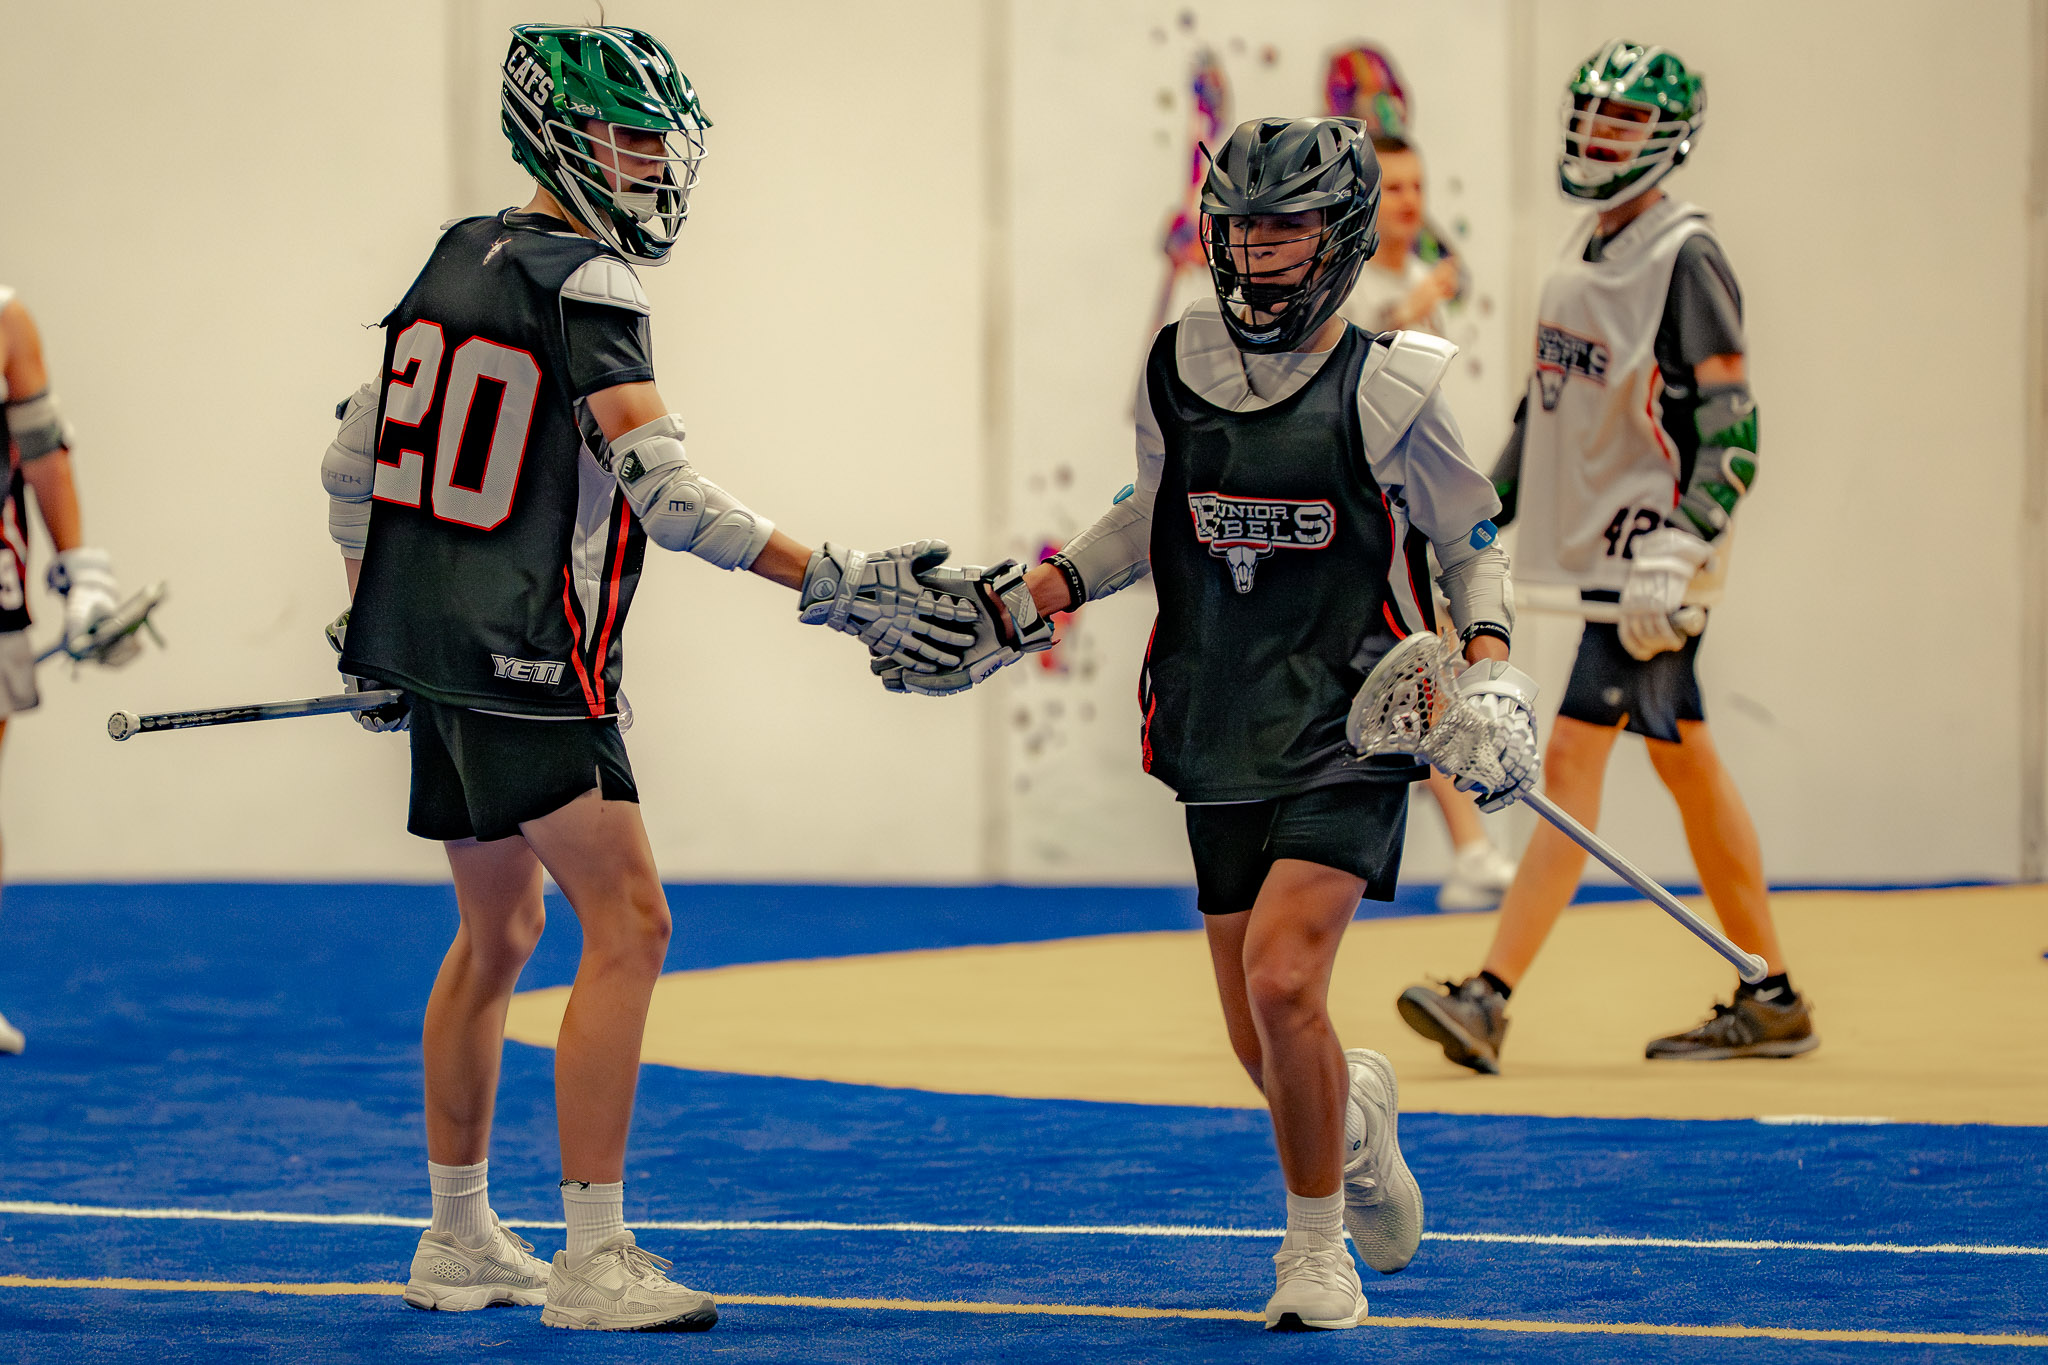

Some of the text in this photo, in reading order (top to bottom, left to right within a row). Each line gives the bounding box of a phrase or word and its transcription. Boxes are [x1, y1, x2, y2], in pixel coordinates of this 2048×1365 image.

[506, 45, 555, 106] CATS
[372, 319, 542, 531] 20
[1191, 497, 1329, 543] RBELS
[1216, 502, 1290, 520] UNIOR
[491, 653, 566, 685] YETI
